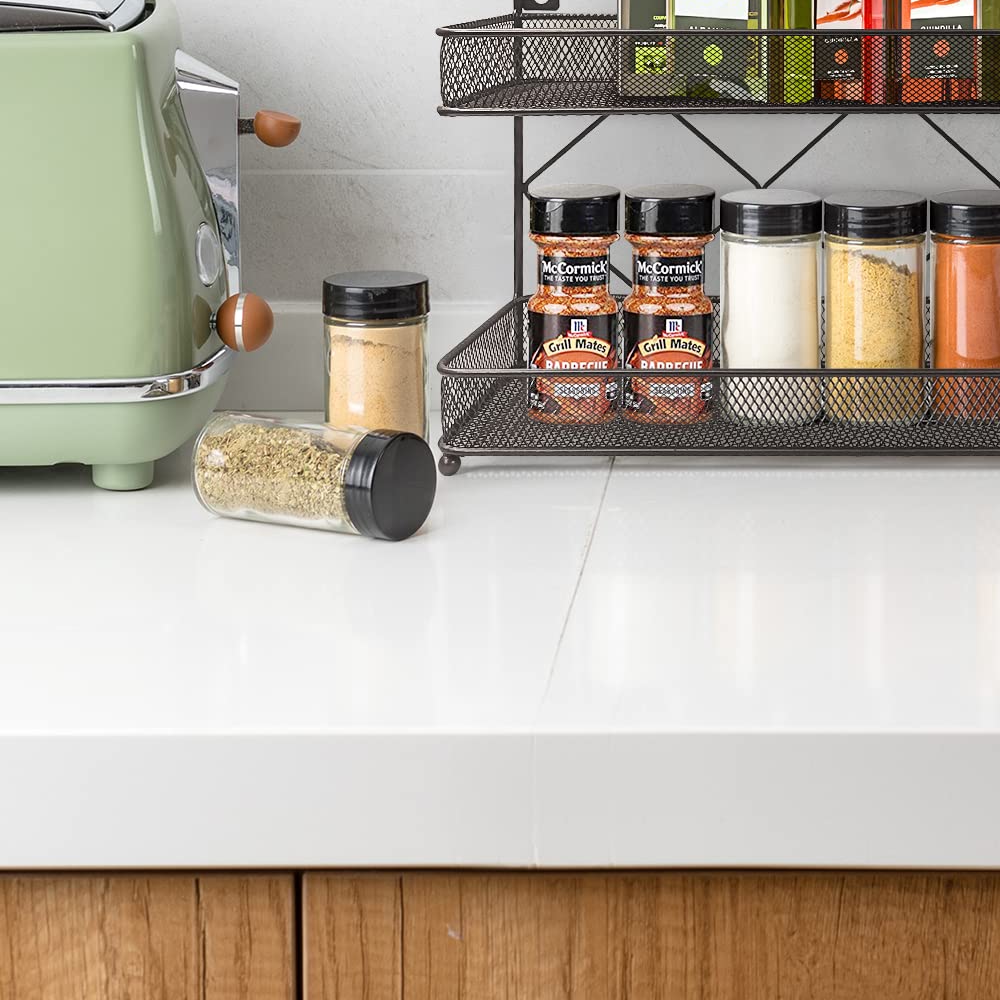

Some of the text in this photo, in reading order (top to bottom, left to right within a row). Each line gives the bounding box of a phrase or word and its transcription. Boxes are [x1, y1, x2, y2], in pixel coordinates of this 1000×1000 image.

[542, 260, 608, 275] McCormick
[637, 260, 703, 275] McCormick
[544, 274, 554, 282] THE
[555, 275, 574, 283] TASTE
[575, 275, 589, 283] YOU
[639, 274, 649, 282] THE
[650, 275, 669, 283] TASTE
[670, 275, 684, 283] YOU
[548, 338, 607, 354] Grill Mates
[643, 338, 702, 354] Grill Mates
